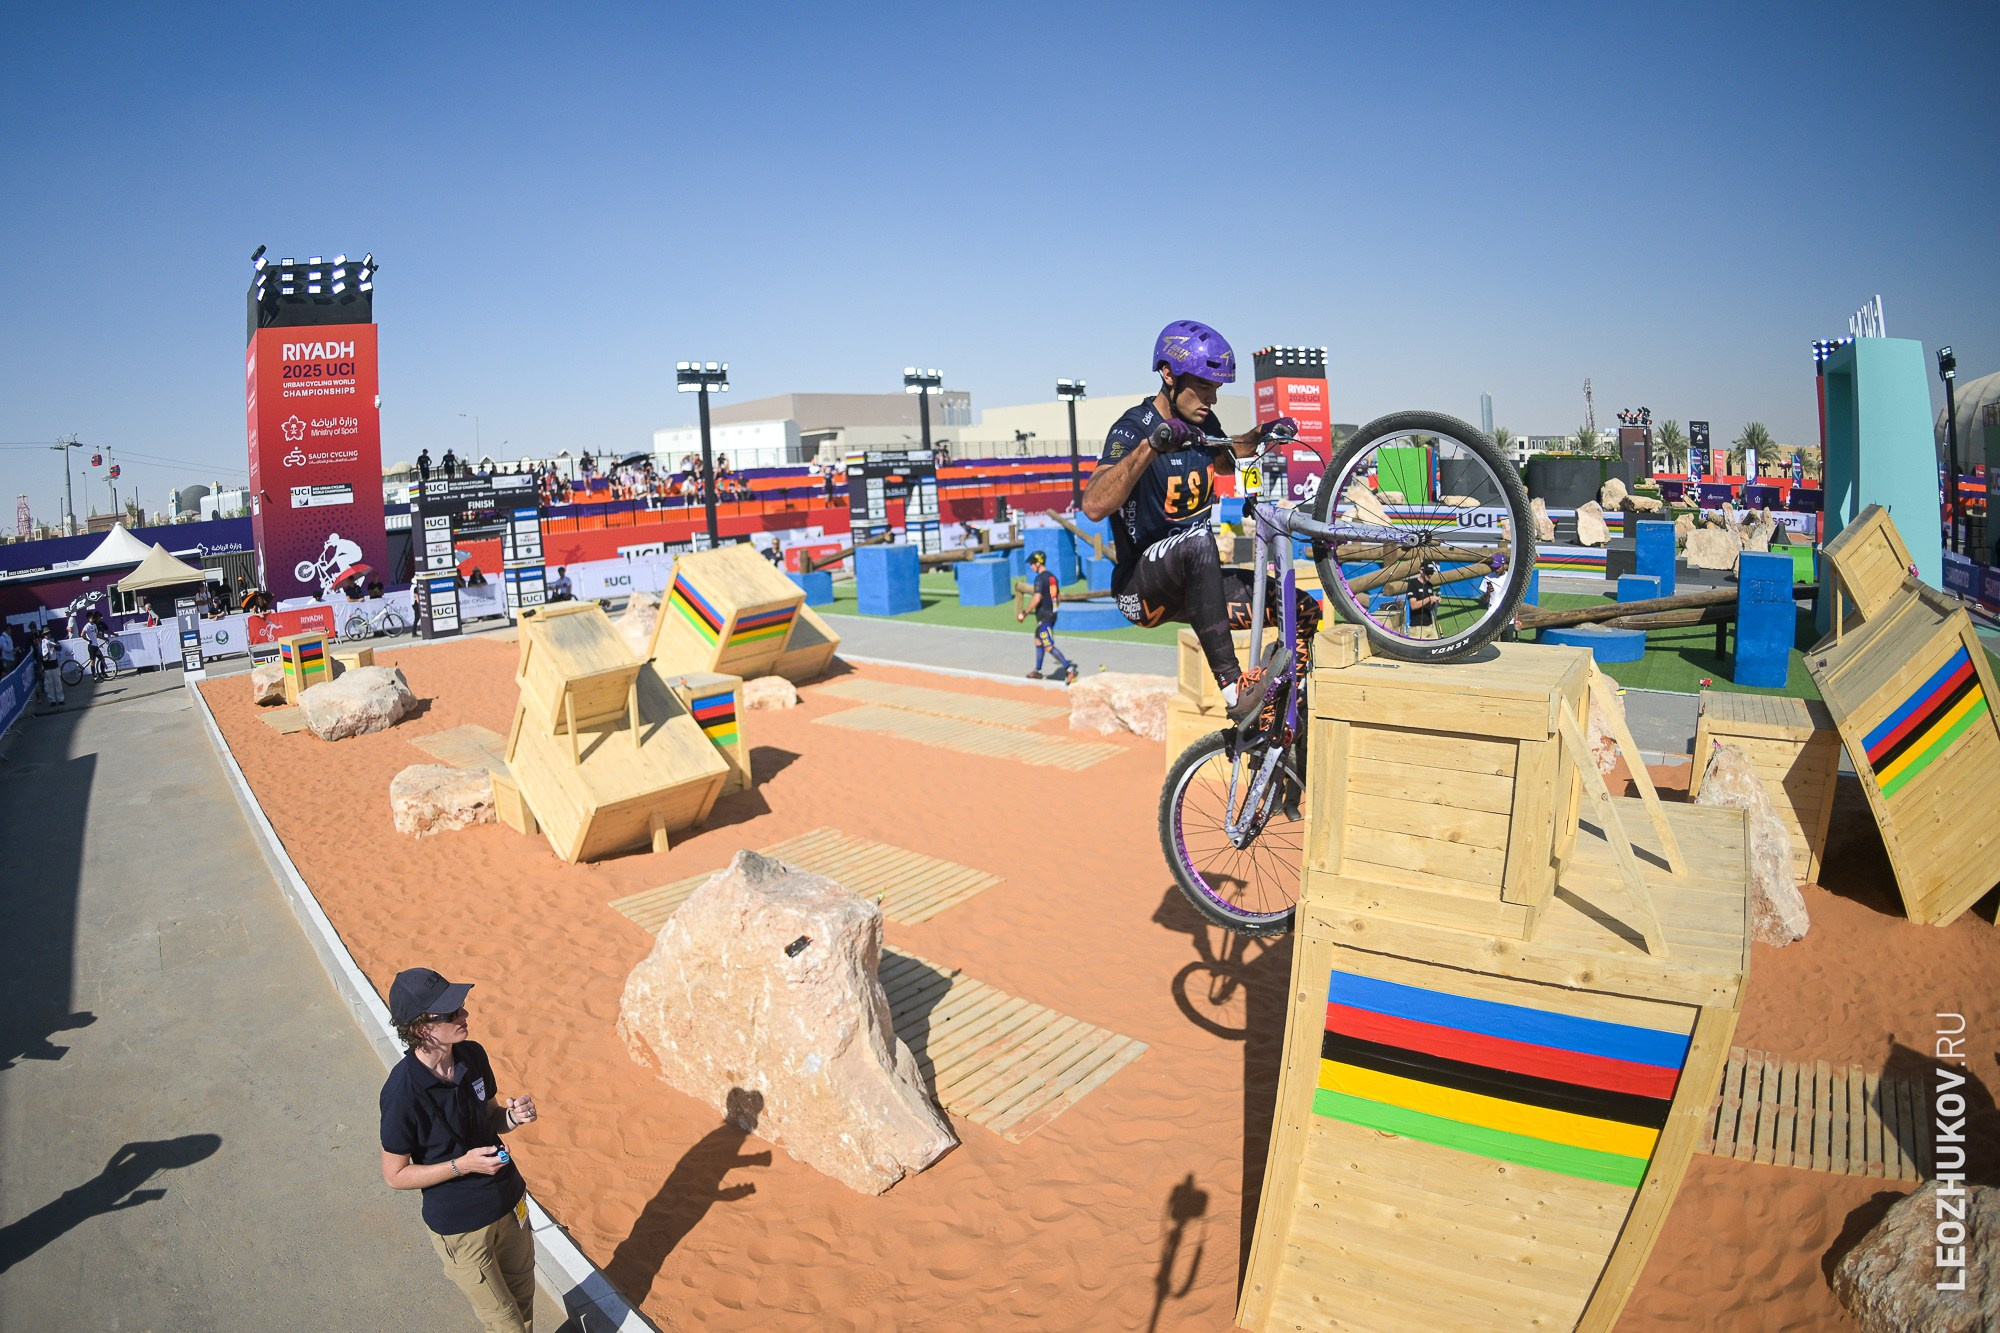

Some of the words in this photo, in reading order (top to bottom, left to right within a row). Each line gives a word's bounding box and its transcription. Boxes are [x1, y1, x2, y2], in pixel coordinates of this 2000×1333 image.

[282, 340, 355, 362] RIYADH
[282, 363, 322, 379] 2025
[326, 362, 355, 377] UCI
[283, 381, 305, 389] URBAN
[305, 379, 333, 387] CYCLING
[333, 378, 356, 386] WORLD
[283, 387, 356, 398] CHAMPIONSHIPS
[1287, 384, 1320, 395] RIYADH
[310, 417, 338, 429] الرياضة
[339, 416, 358, 428] وزارة
[310, 429, 334, 437] Ministry
[340, 427, 358, 436] Sport
[308, 452, 329, 460] SAUDI
[330, 450, 359, 458] CYCLING
[294, 487, 310, 496] UCI
[429, 483, 446, 493] UCI
[467, 499, 495, 510] FINISH
[429, 518, 447, 527] UCI
[1125, 500, 1136, 544] ofidis
[1458, 513, 1493, 528] UCI
[609, 575, 631, 586] UCI
[526, 594, 542, 603] UCI
[178, 608, 197, 617] START
[437, 606, 455, 616] UCI
[185, 615, 192, 630] 1
[300, 614, 324, 624] RIYADH
[1431, 637, 1470, 655] KENDA
[266, 655, 280, 664] UC
